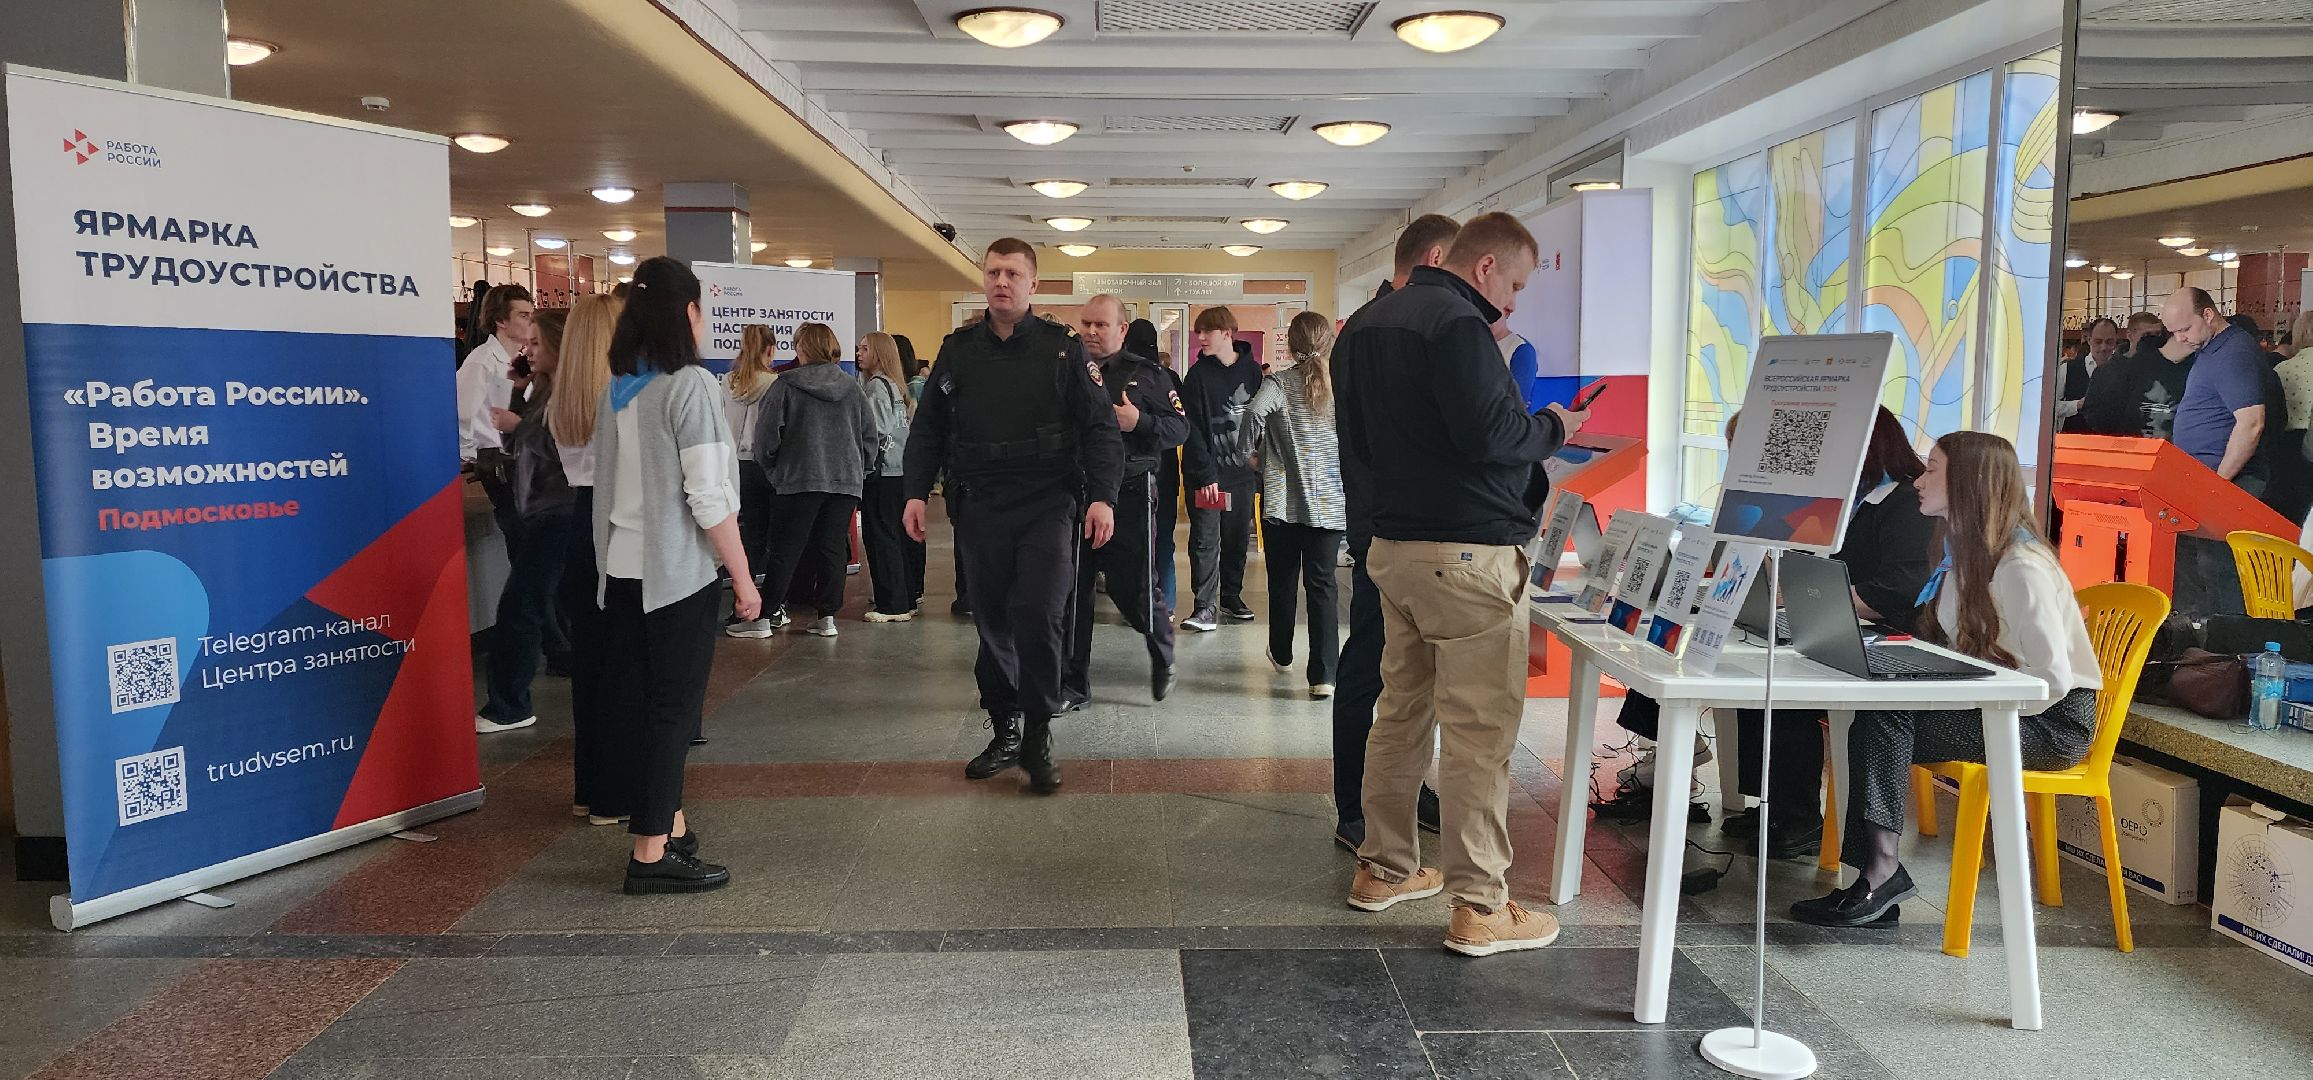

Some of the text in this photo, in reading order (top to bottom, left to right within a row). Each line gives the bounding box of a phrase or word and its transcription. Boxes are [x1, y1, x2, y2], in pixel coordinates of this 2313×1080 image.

[106, 140, 158, 156] РАБОТА
[107, 153, 161, 168] РОССИИ
[73, 208, 259, 249] ЯРМАРКА
[76, 250, 419, 297] ТРУДОУСТРОЙСТВА
[712, 306, 834, 321] ЦЕНТР ЗАНЯТОСТИ
[712, 322, 793, 335] НАСЕНИЯ
[63, 378, 369, 408] «Работа России».
[88, 422, 209, 454] Время
[92, 451, 349, 491] возможностей
[98, 499, 300, 532] Подмосковье
[198, 611, 391, 658] Telegram-канал
[202, 636, 417, 690] Центра занятости
[207, 734, 355, 783] trudvsem.ru
[2256, 931, 2267, 943] ИХ
[2267, 937, 2305, 961] СДЕЛАЛИ!
